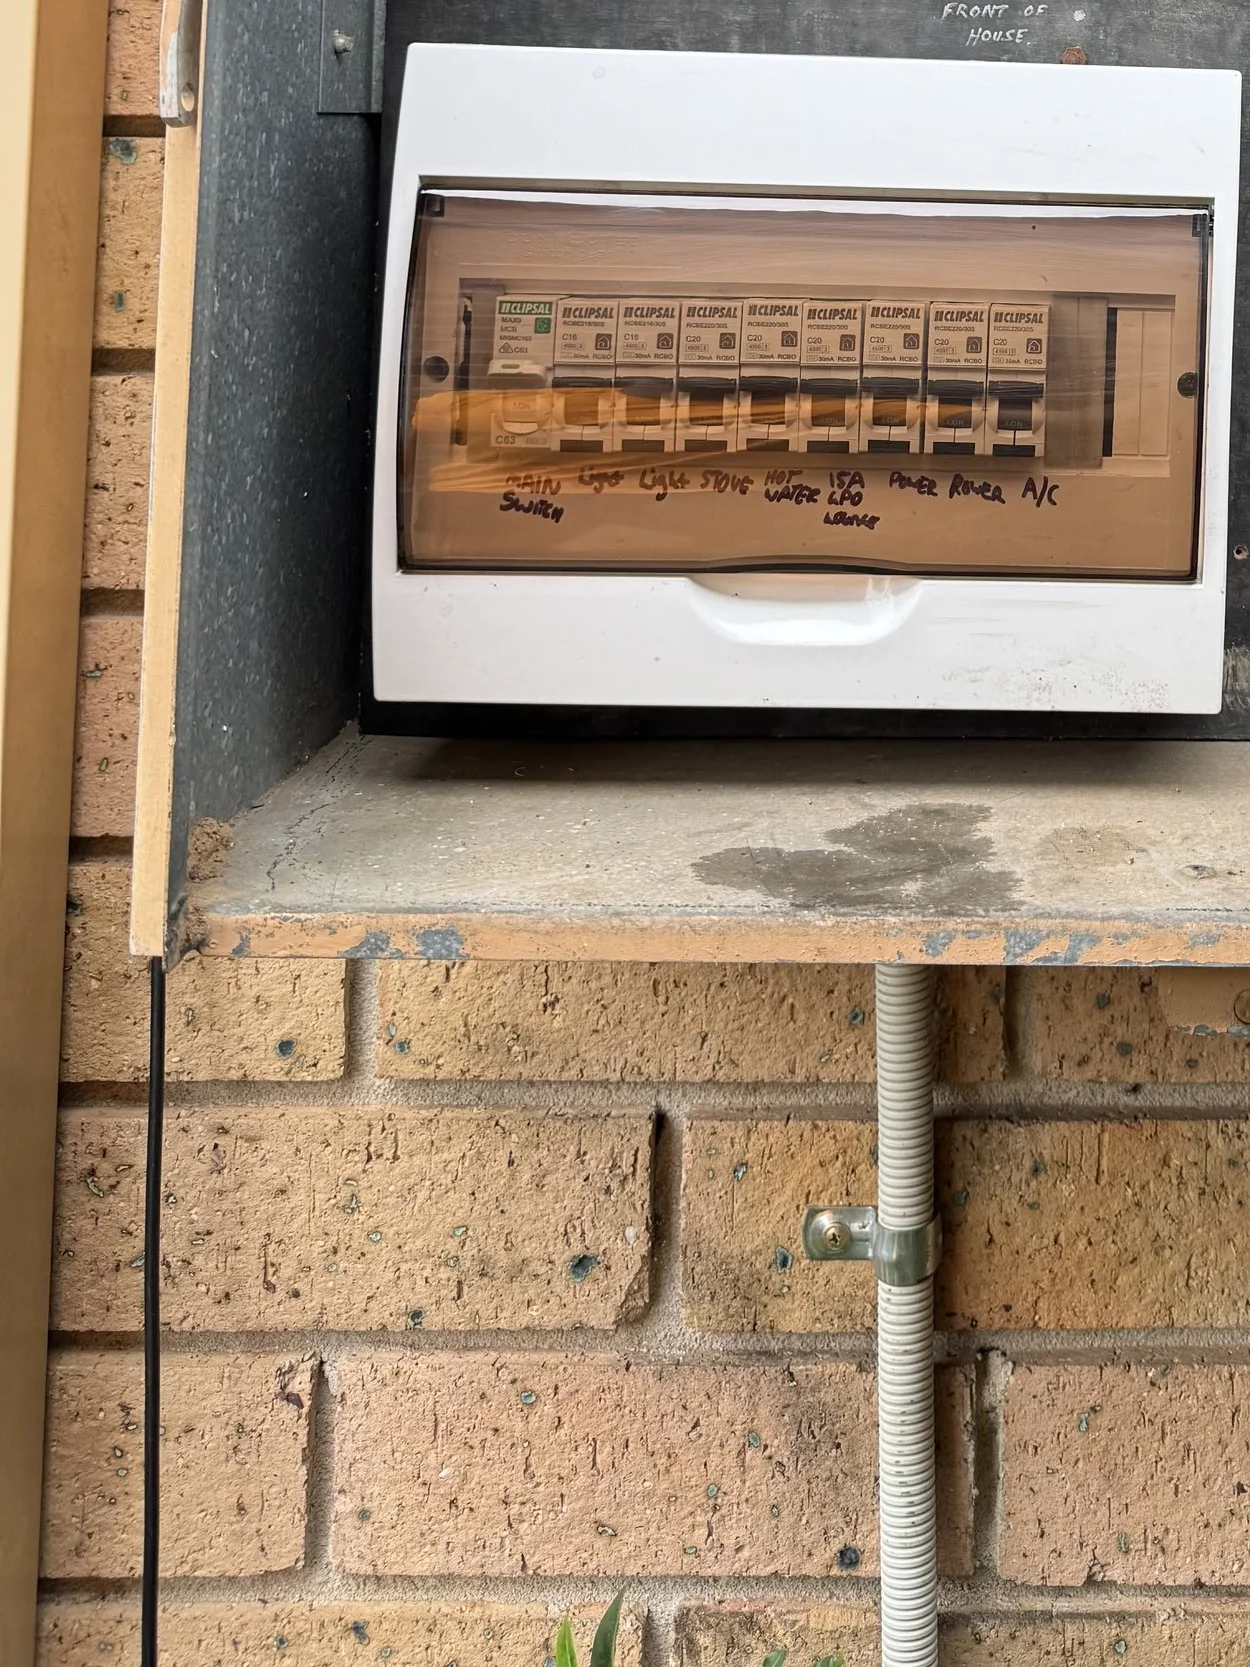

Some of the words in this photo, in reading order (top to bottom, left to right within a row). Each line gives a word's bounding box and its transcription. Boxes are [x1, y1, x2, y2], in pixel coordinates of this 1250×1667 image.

[941, 2, 1009, 21] FRONT
[1024, 4, 1048, 16] OF
[510, 302, 550, 314] CLIPSAL
[572, 307, 614, 318] CLIPSAL
[634, 306, 675, 318] CLIPSAL
[696, 306, 738, 318] CLIPSAL
[758, 304, 799, 316] CLIPSAL
[817, 308, 858, 320] CLIPSAL
[880, 306, 920, 319] CLIPSAL
[944, 310, 984, 322] CLIPSAL
[1004, 312, 1044, 324] CLIPSAL
[747, 334, 762, 342] C20
[870, 336, 885, 344] C20
[934, 338, 950, 346] C20
[994, 338, 1008, 346] C20
[496, 436, 516, 444] C63
[700, 469, 754, 495] STOVE
[764, 469, 803, 486] HOT
[829, 470, 865, 488] 15A
[638, 468, 690, 502] Light
[764, 484, 822, 505] WATER
[1021, 476, 1060, 508] A/C
[500, 489, 564, 524] SWITCH
